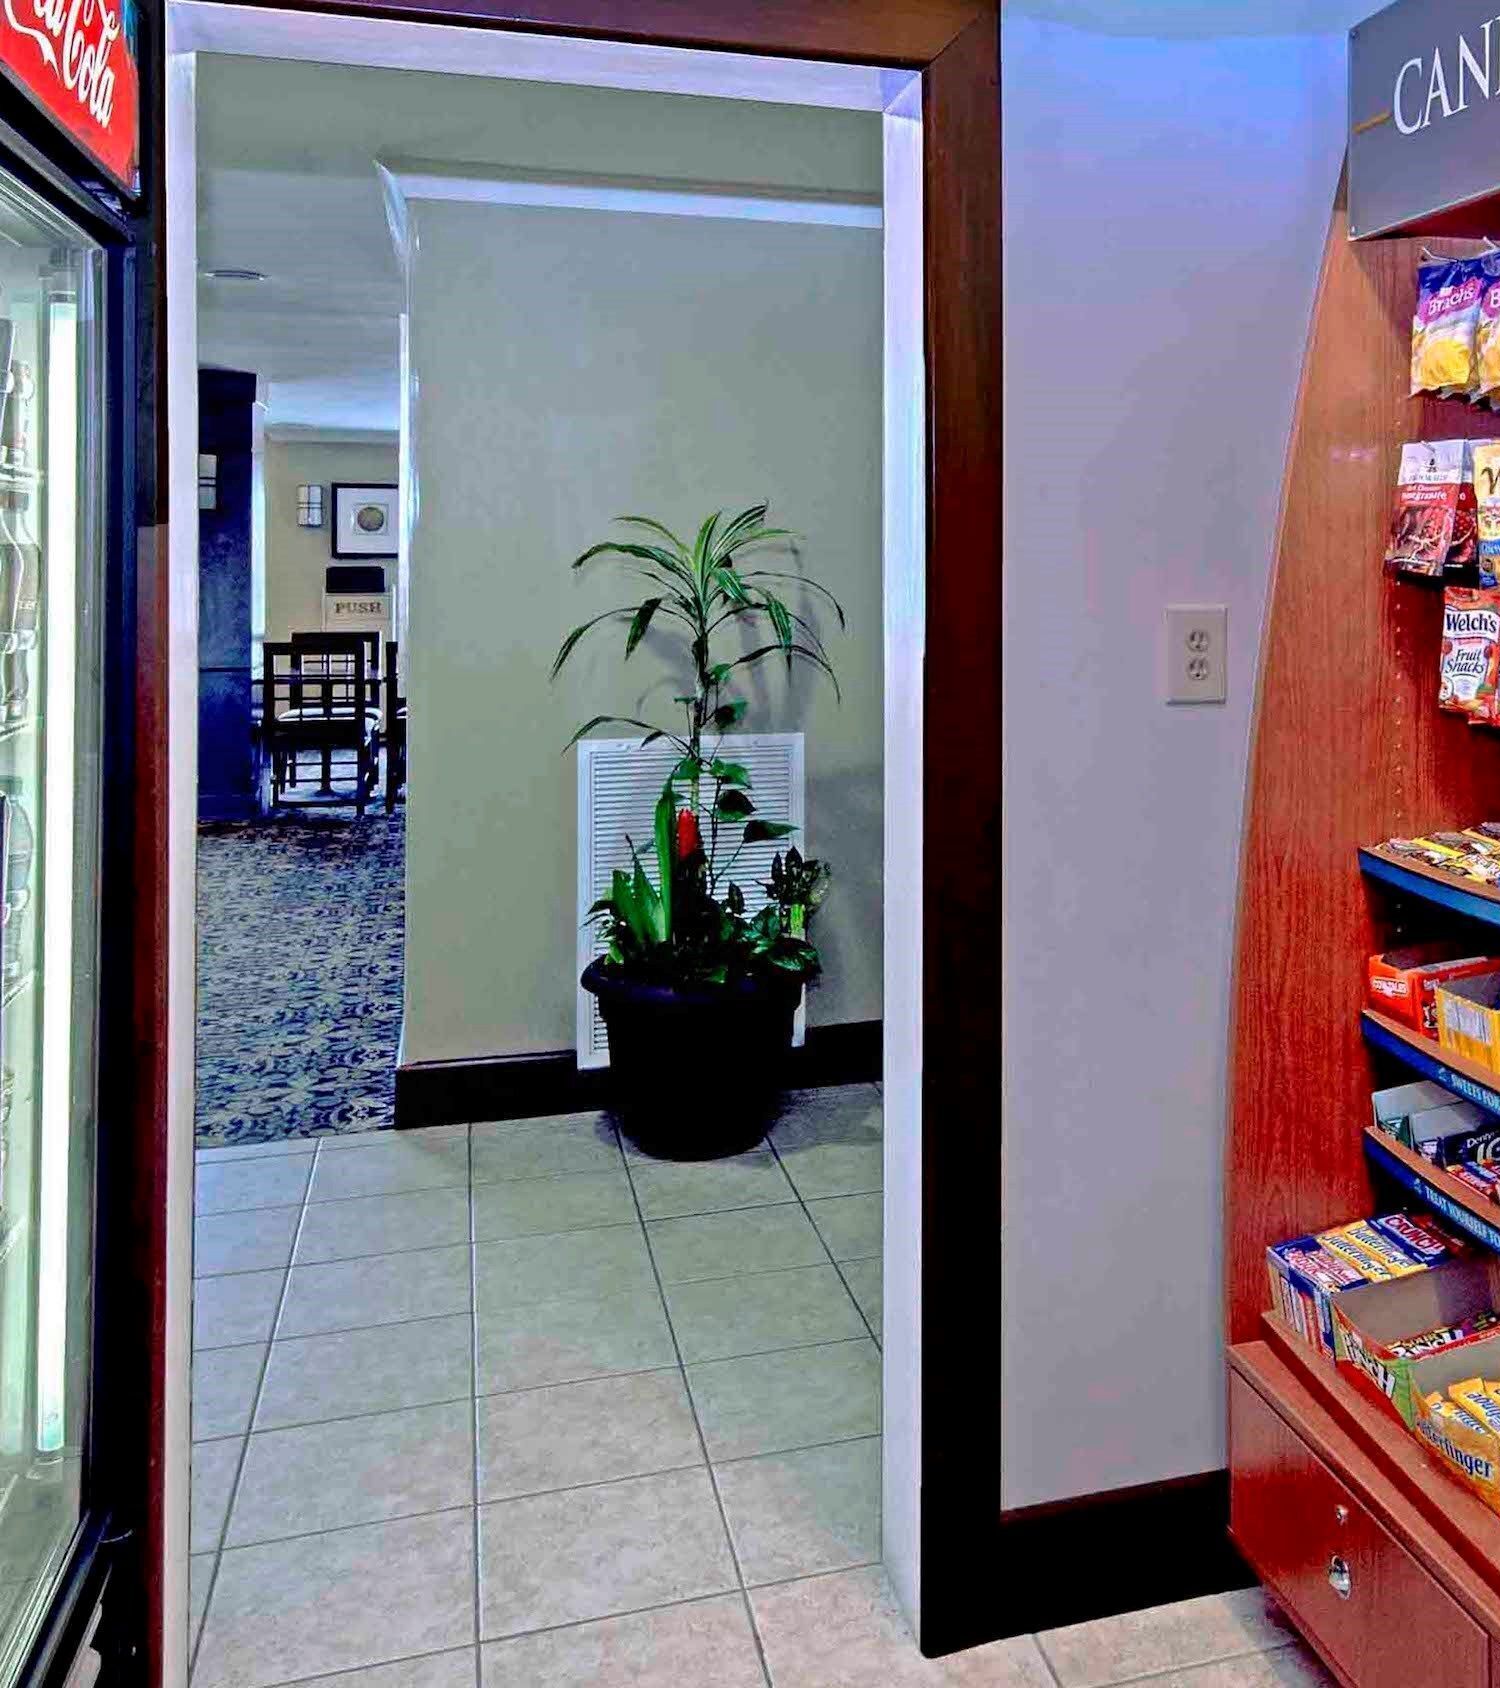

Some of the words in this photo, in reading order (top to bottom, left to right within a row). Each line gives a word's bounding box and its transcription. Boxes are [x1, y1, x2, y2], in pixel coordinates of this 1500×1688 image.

[335, 601, 383, 615] PUSH
[1445, 613, 1498, 634] Welch's
[1455, 648, 1482, 662] Fruit
[1444, 659, 1484, 674] Snacks
[1482, 1089, 1500, 1110] FOR
[1424, 1185, 1450, 1215] TREAT
[1449, 1201, 1489, 1240] YOURSELF
[1489, 1228, 1500, 1246] TO
[1385, 1215, 1446, 1256] CRUNCH
